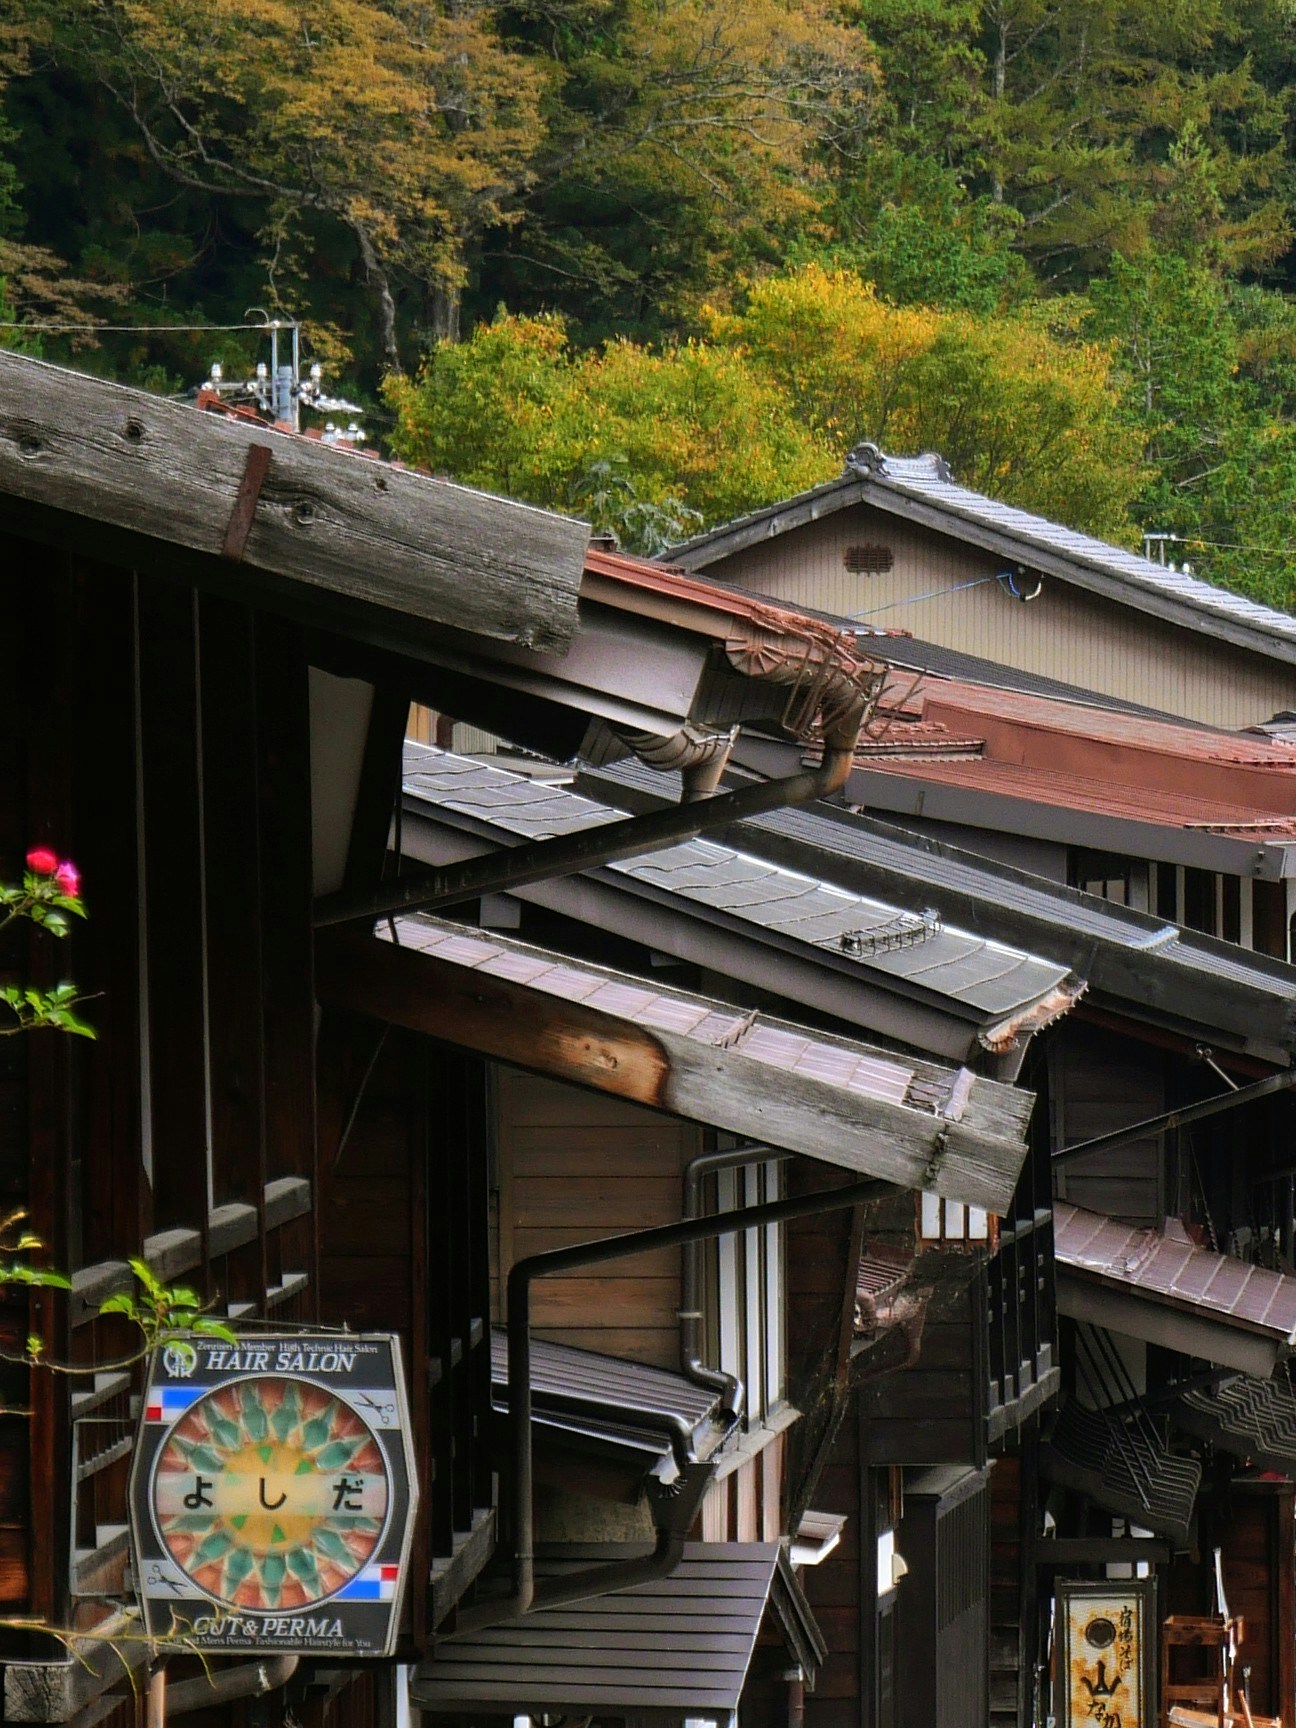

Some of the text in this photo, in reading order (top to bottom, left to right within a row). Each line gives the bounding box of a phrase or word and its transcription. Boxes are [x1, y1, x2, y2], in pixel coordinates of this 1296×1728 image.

[242, 1342, 275, 1351] Member
[279, 1342, 300, 1353] High
[302, 1343, 334, 1353] Technic
[335, 1344, 352, 1353] Hair
[354, 1344, 378, 1354] Salon
[206, 1351, 357, 1372] HAIR SALON
[183, 1475, 364, 1511] よしだ
[256, 1637, 303, 1646] Fashionable
[304, 1638, 340, 1648] Hairstyle
[342, 1638, 353, 1647] for
[356, 1639, 371, 1647] You
